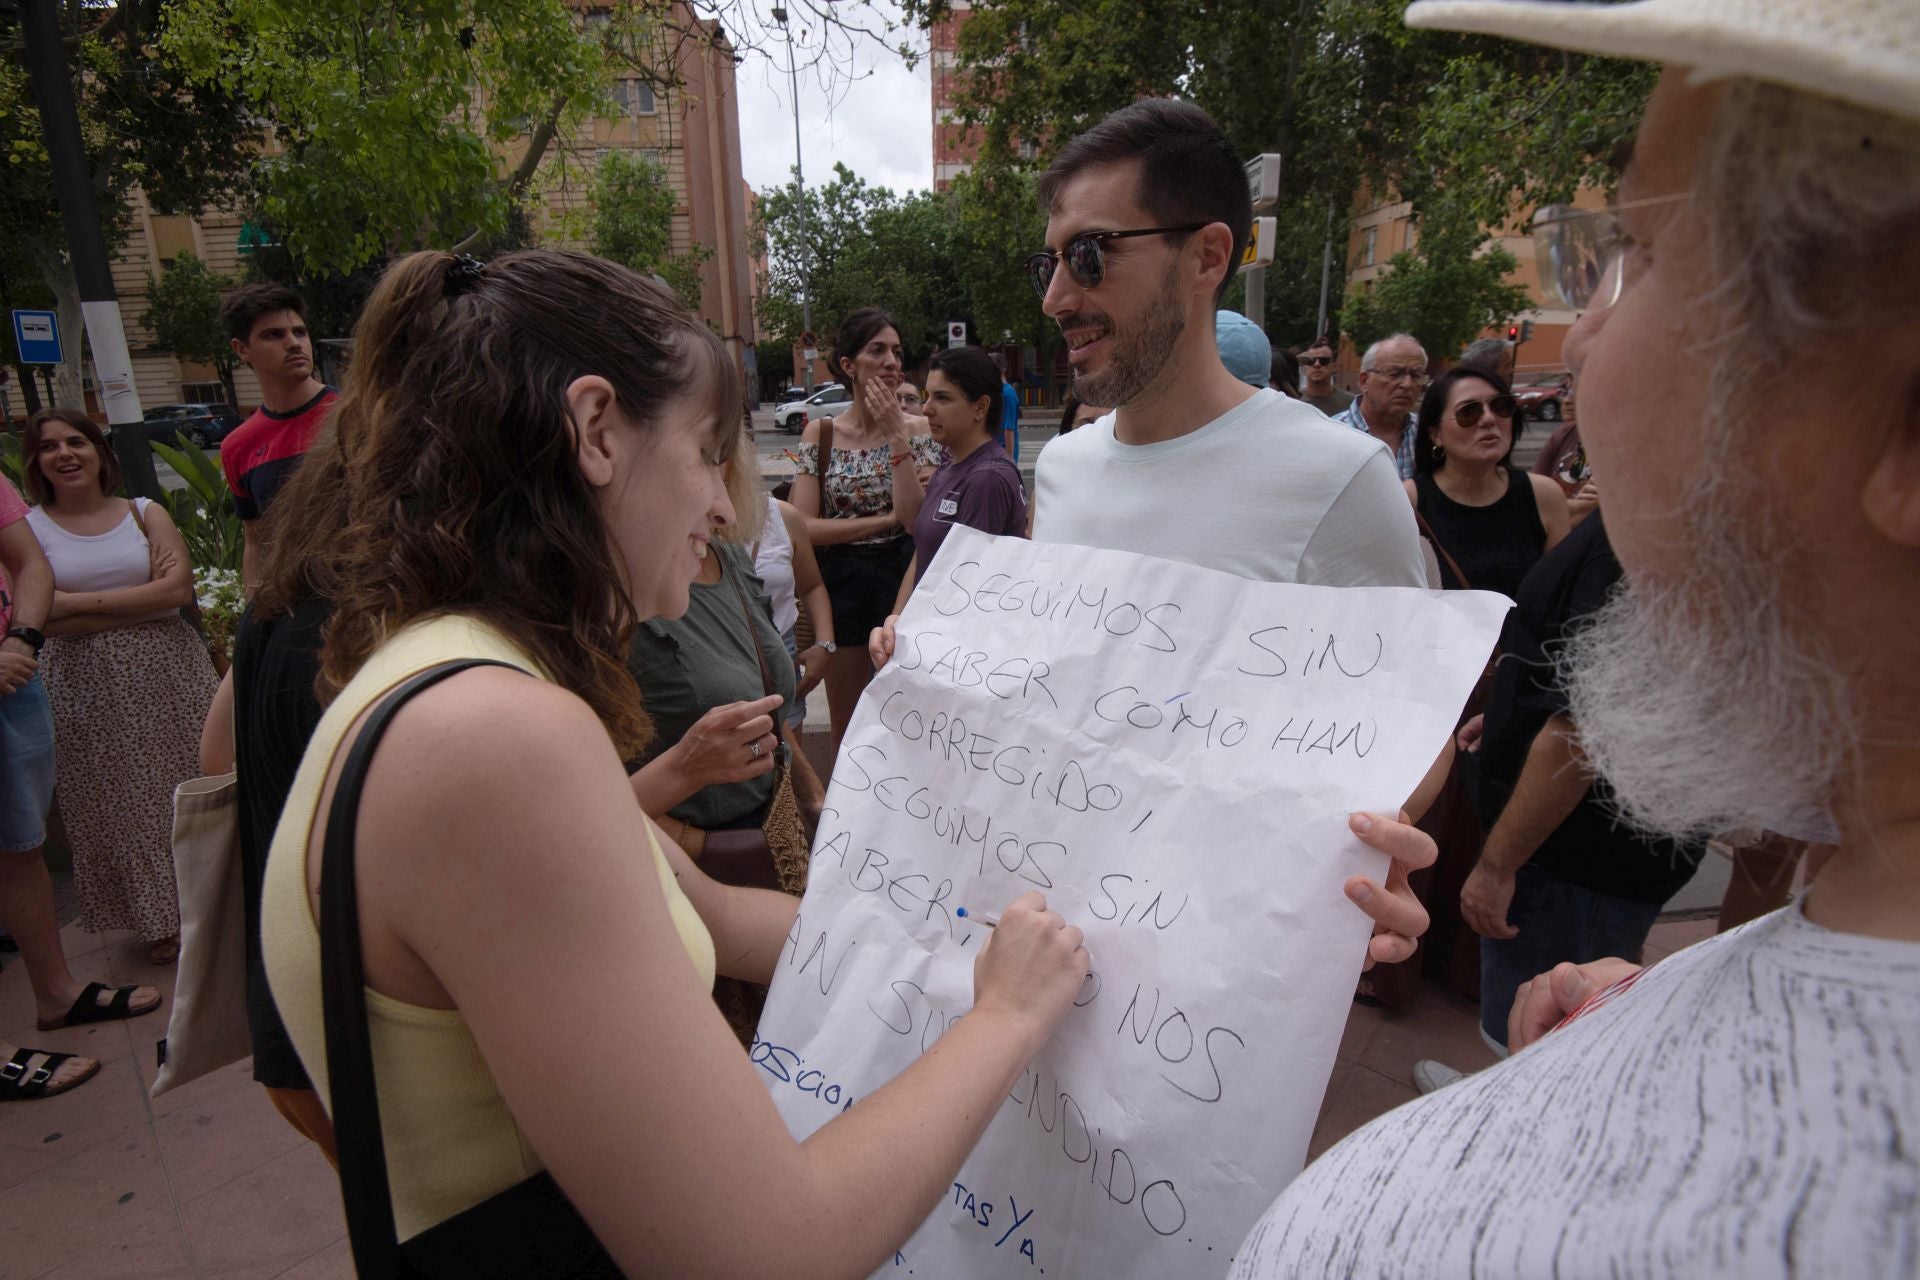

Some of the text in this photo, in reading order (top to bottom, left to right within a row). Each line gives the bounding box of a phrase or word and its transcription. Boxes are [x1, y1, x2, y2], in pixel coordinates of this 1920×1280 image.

[898, 631, 1059, 710] SABER
[1271, 716, 1377, 759] HAN
[1117, 983, 1245, 1102] NOS
